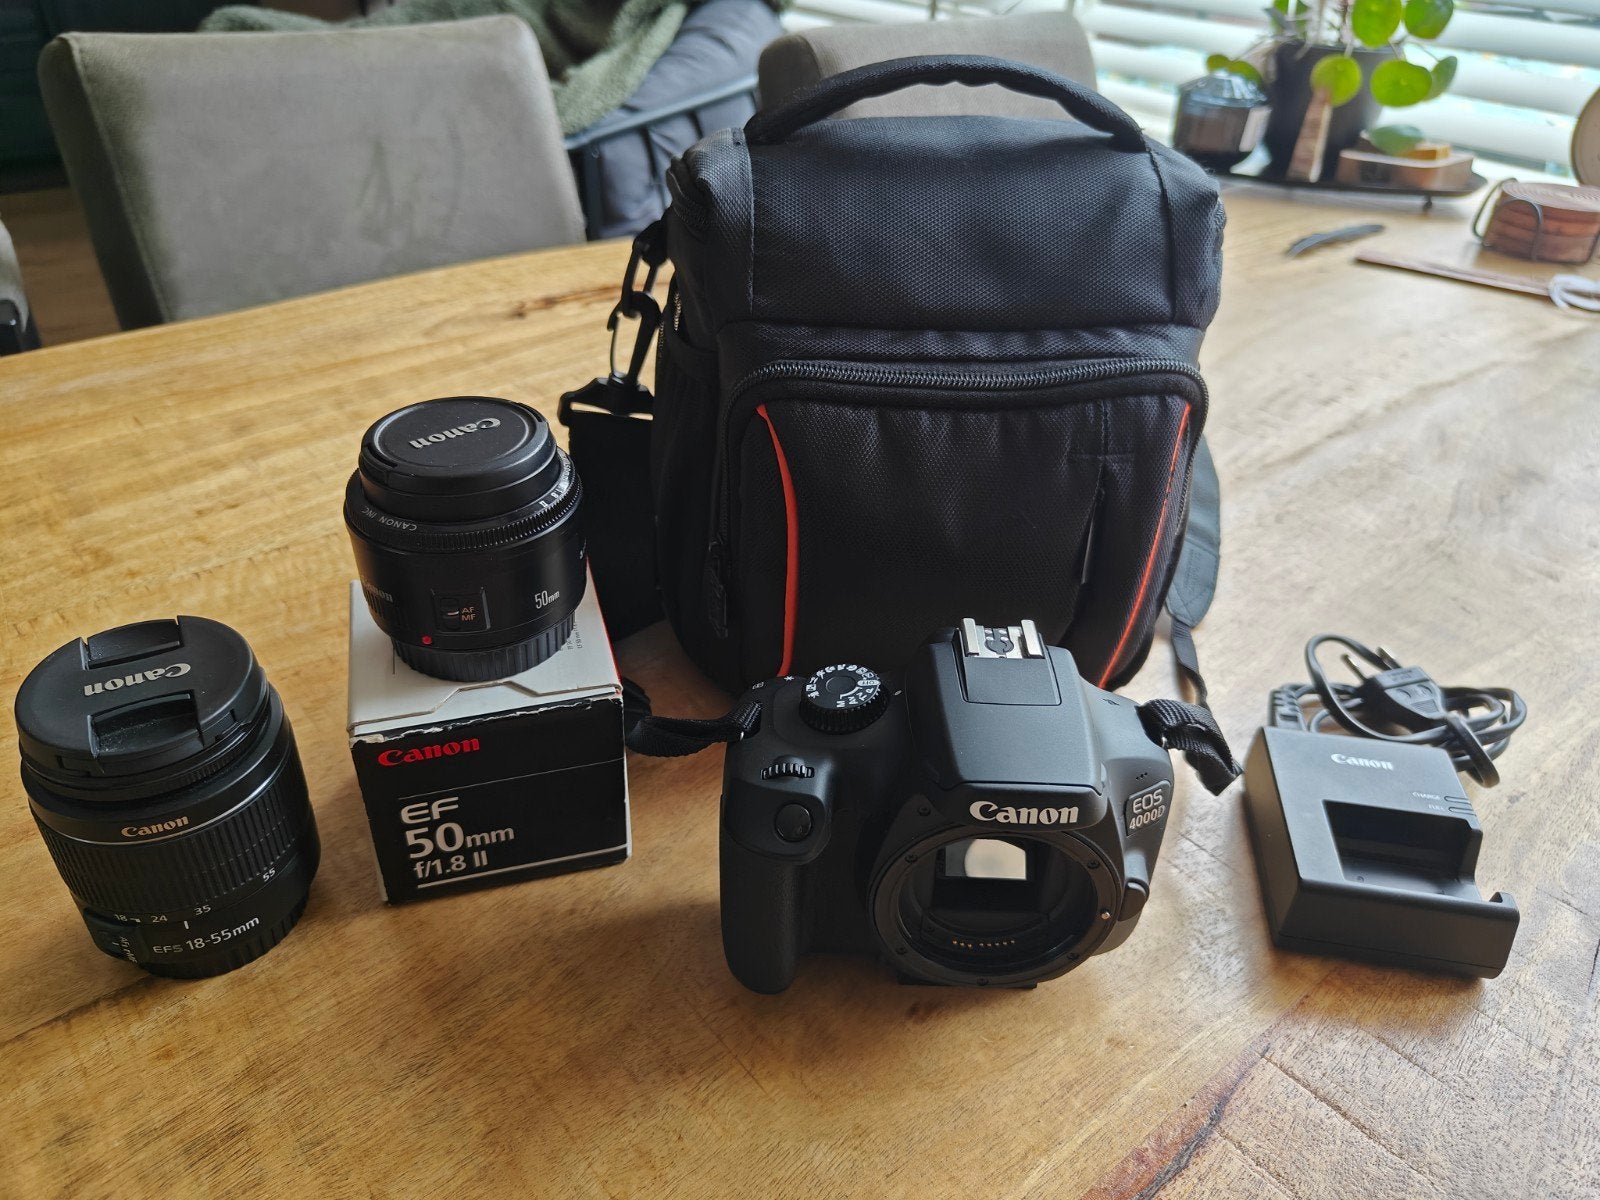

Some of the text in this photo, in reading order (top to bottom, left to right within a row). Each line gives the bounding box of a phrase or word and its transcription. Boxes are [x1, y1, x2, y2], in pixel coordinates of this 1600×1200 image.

[409, 417, 501, 449] Canon
[379, 516, 417, 531] CANON
[461, 606, 475, 614] AF
[534, 590, 560, 609] 50mm
[461, 613, 477, 621] MF
[84, 662, 191, 697] Canon
[378, 738, 480, 767] Canon
[1330, 753, 1394, 770] Canon
[401, 797, 459, 825] EF
[969, 800, 1079, 826] Canon
[1133, 788, 1163, 814] EOS
[121, 815, 190, 838] Canon
[1129, 804, 1166, 830] 4000D
[406, 822, 515, 859] 50mm
[262, 867, 278, 882] 55
[413, 850, 489, 880] f/1.8 II
[151, 915, 168, 923] 24
[194, 904, 212, 916] 35
[186, 916, 260, 951] 18-55mm
